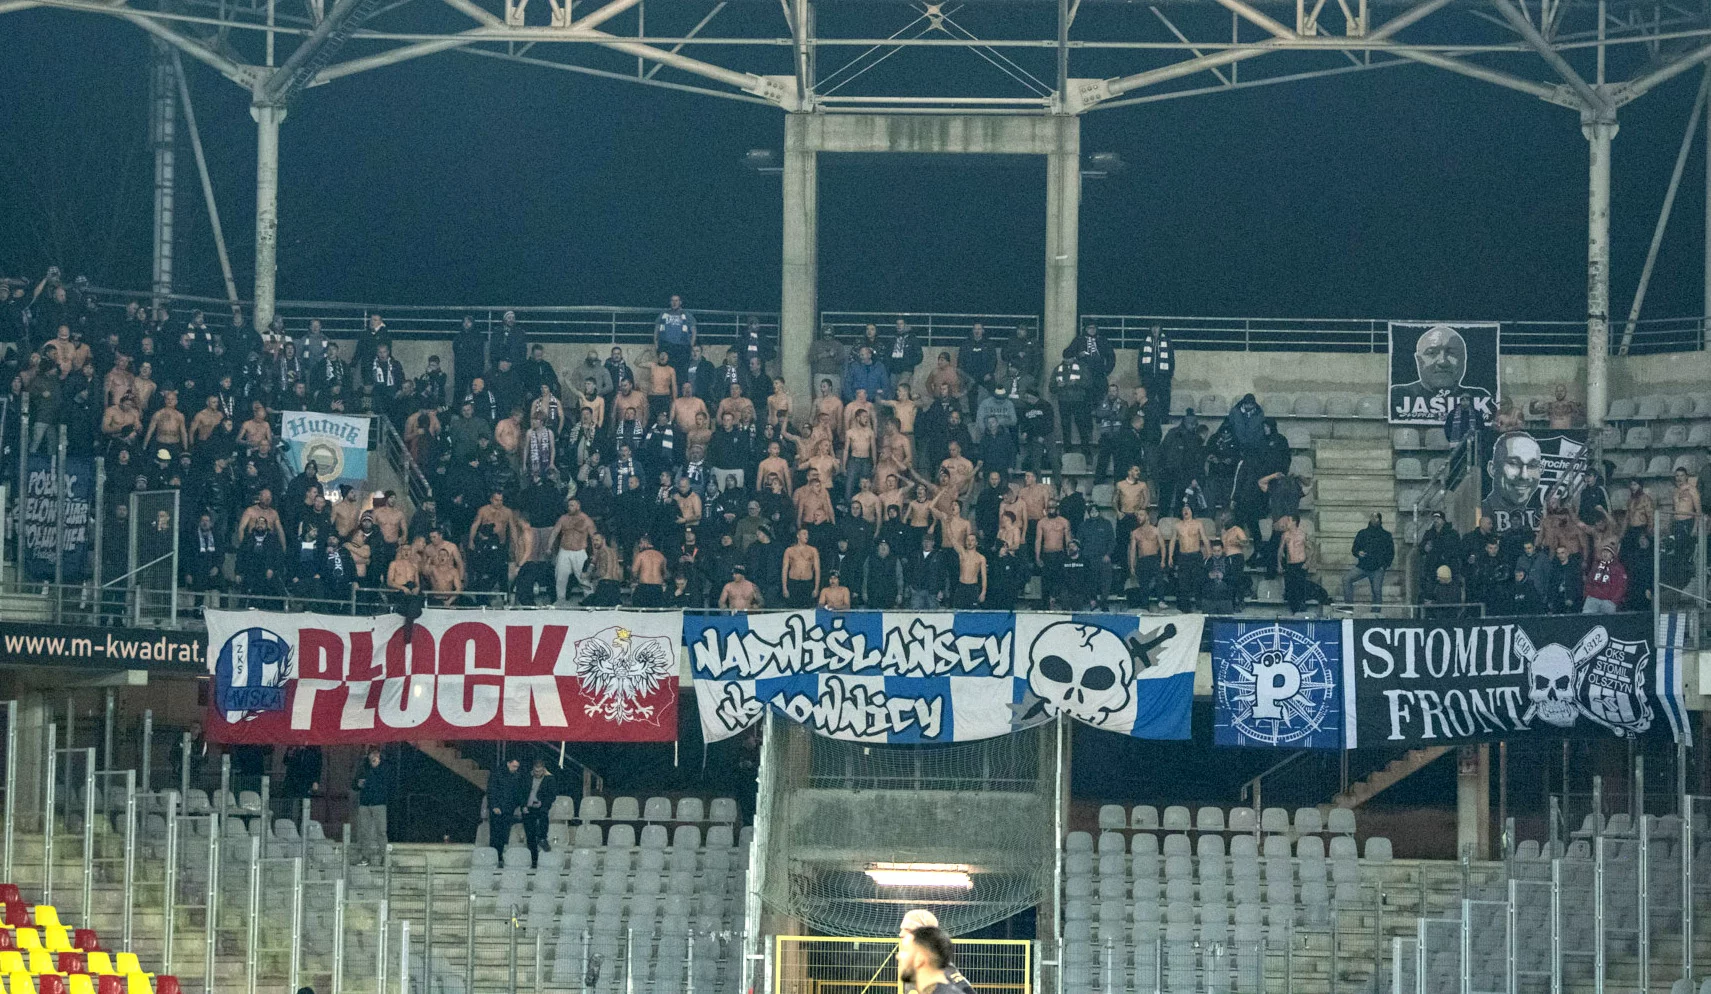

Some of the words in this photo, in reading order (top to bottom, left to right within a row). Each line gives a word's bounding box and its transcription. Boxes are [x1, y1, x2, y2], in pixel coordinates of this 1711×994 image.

[1396, 396, 1492, 415] JASIK
[287, 416, 361, 445] Hutnik
[1361, 624, 1524, 679] STOMIL
[1515, 633, 1531, 655] ACAB
[1583, 633, 1604, 656] 1312
[1604, 648, 1626, 662] OKS
[291, 621, 569, 731] PŁOCK
[1595, 660, 1629, 679] STOMIL
[1588, 673, 1634, 694] OLSZTYN
[1382, 686, 1532, 741] FRONT
